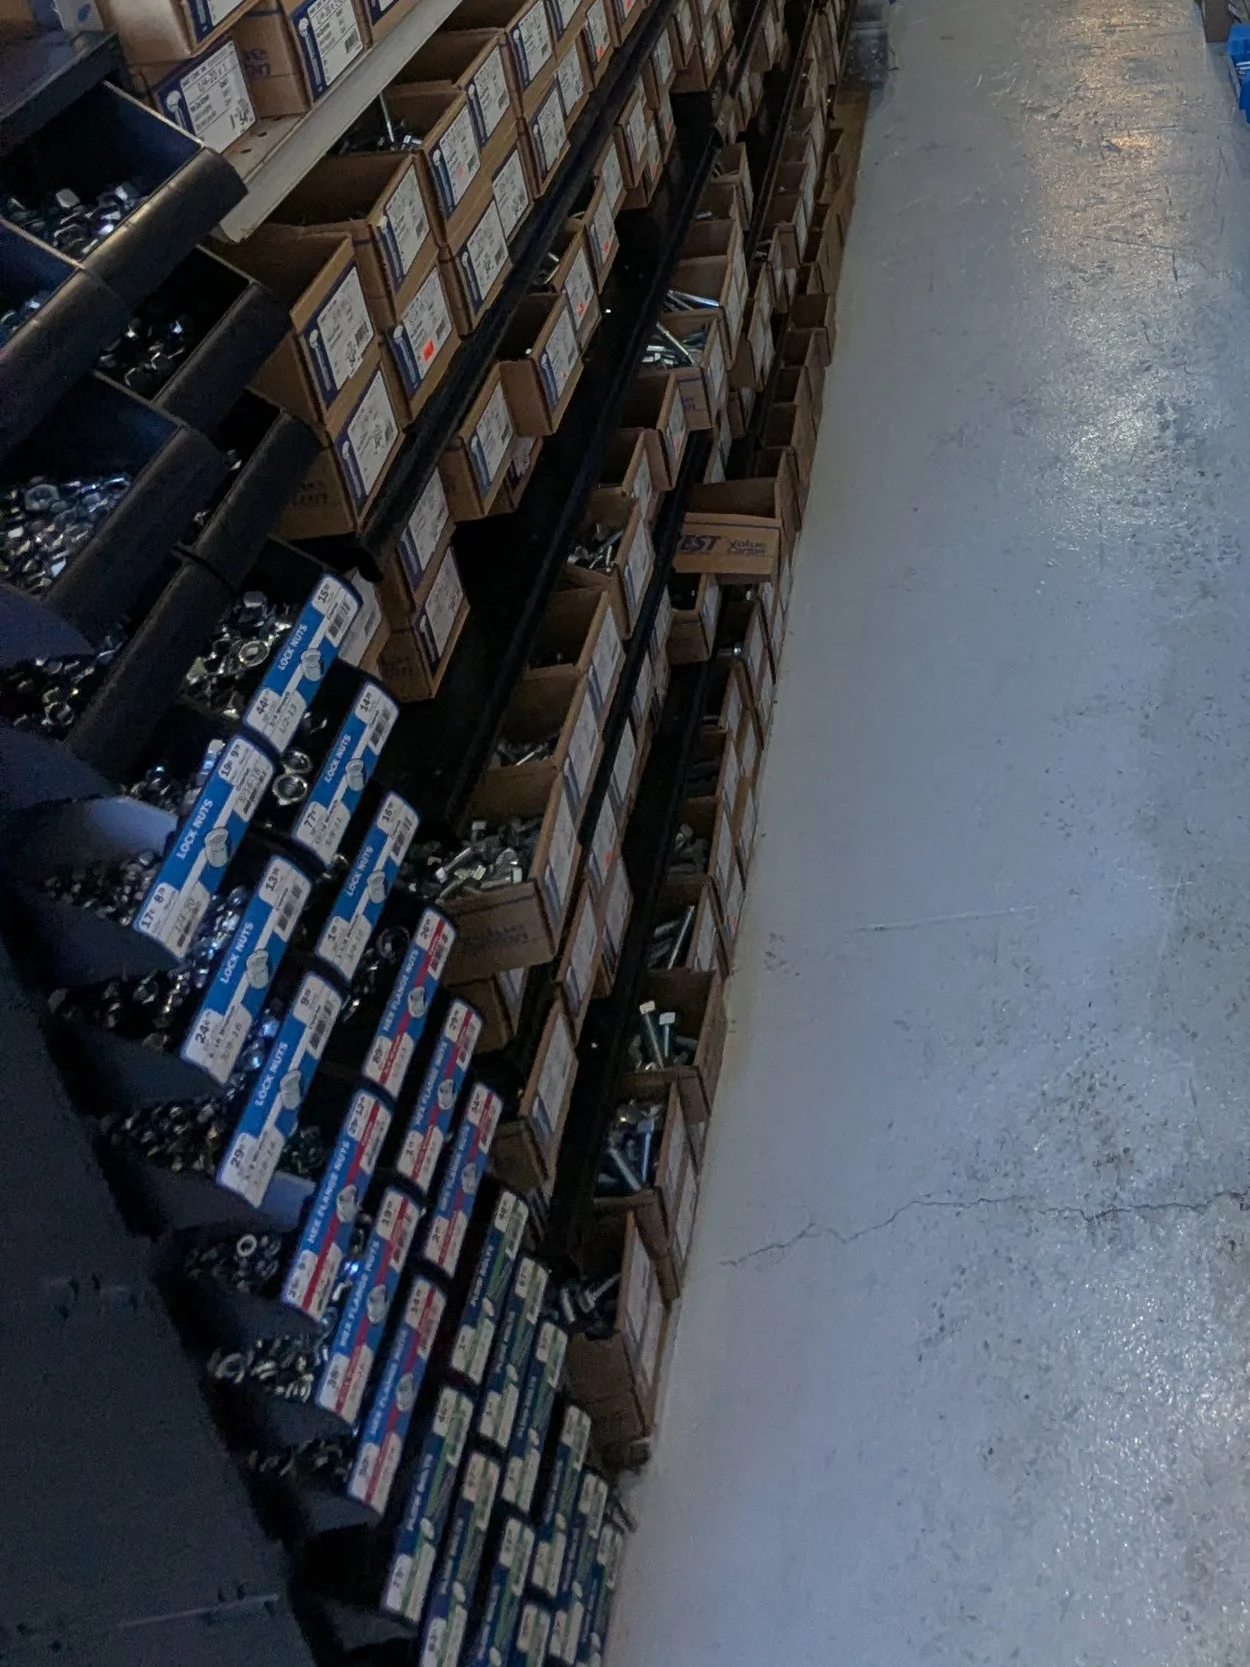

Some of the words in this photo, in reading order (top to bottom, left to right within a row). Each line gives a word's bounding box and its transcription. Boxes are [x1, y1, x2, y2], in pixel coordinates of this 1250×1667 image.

[278, 646, 295, 672] LOCK
[293, 624, 308, 650] NUTS
[325, 757, 341, 784] LOCK
[337, 734, 352, 761] NUTS
[176, 828, 198, 861] LOCK
[194, 798, 214, 830] NUTS
[220, 954, 238, 985] LOCK
[235, 921, 254, 955] NUTS
[254, 1074, 271, 1107] LOCK
[269, 1040, 290, 1075] NUTS
